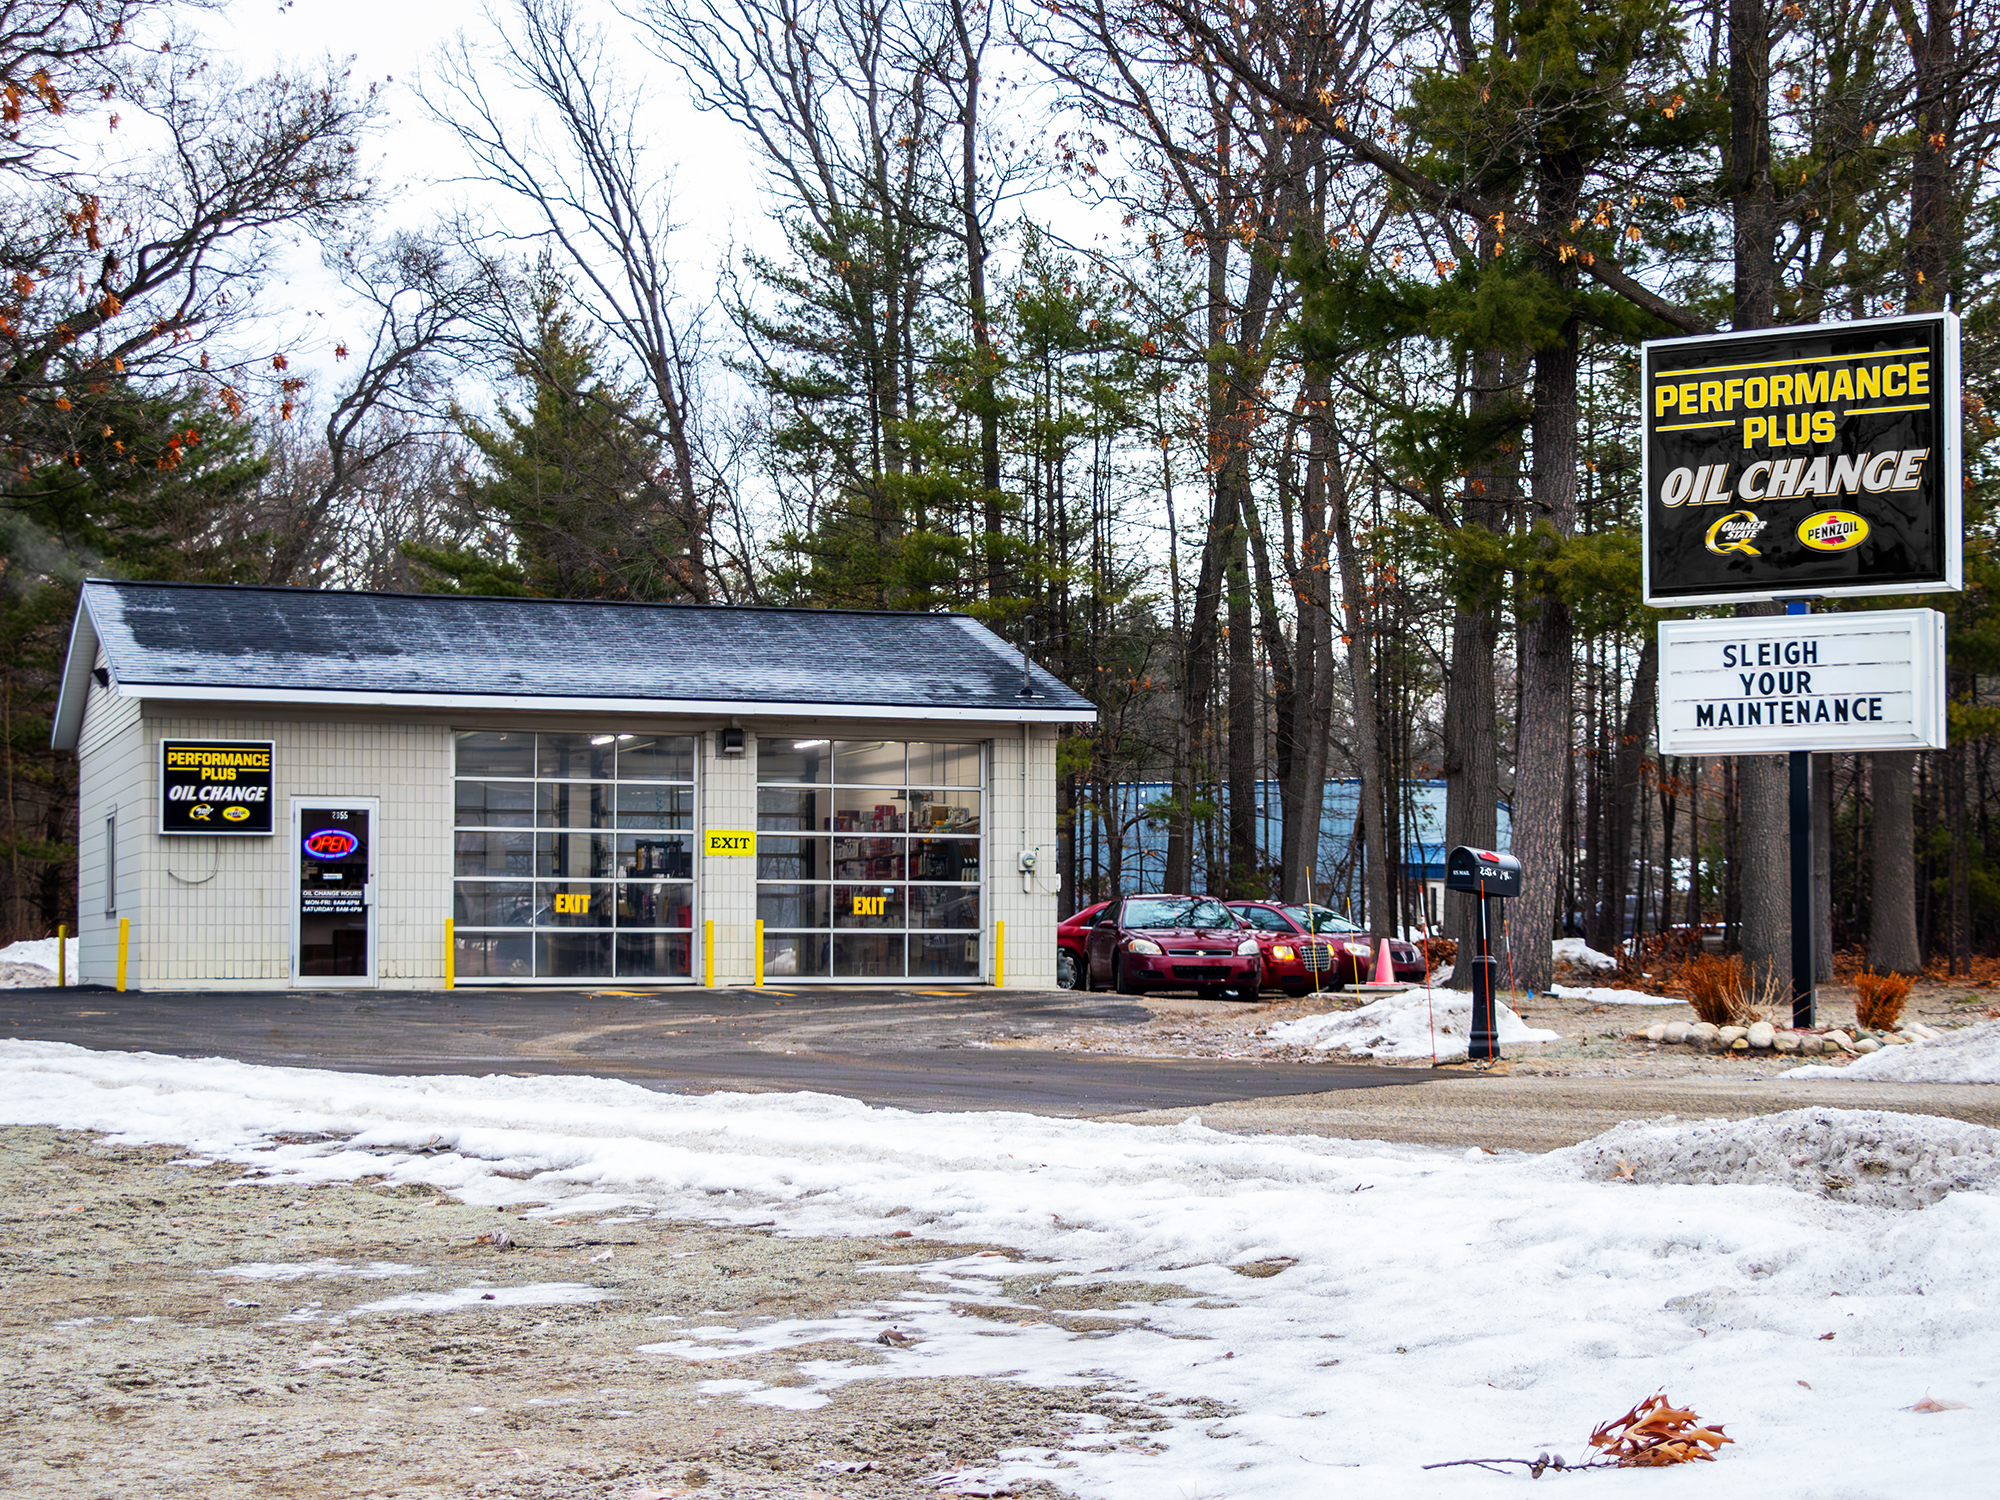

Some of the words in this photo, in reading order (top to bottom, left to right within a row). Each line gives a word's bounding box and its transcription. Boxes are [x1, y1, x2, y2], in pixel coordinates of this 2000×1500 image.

[1655, 361, 1930, 417] PERFORMANCE
[1743, 410, 1836, 449] PLUS
[1660, 463, 1733, 508] OIL
[1738, 447, 1930, 502] CHANGE
[1721, 521, 1767, 532] QUAKER
[1725, 530, 1759, 540] STATE
[1807, 521, 1859, 541] PENNZOIL
[1723, 641, 1818, 668] SLEIGH
[1739, 671, 1813, 696] YOUR
[1696, 697, 1883, 727] MAINTENANCE
[167, 752, 270, 766] PERFORMANCE
[201, 767, 237, 781] PLUS
[168, 785, 198, 801] OIL
[198, 785, 268, 802] CHANGE
[308, 835, 353, 853] OPEN
[710, 836, 751, 850] EXIT
[555, 893, 591, 914] EXIT
[853, 896, 887, 915] EXIT
